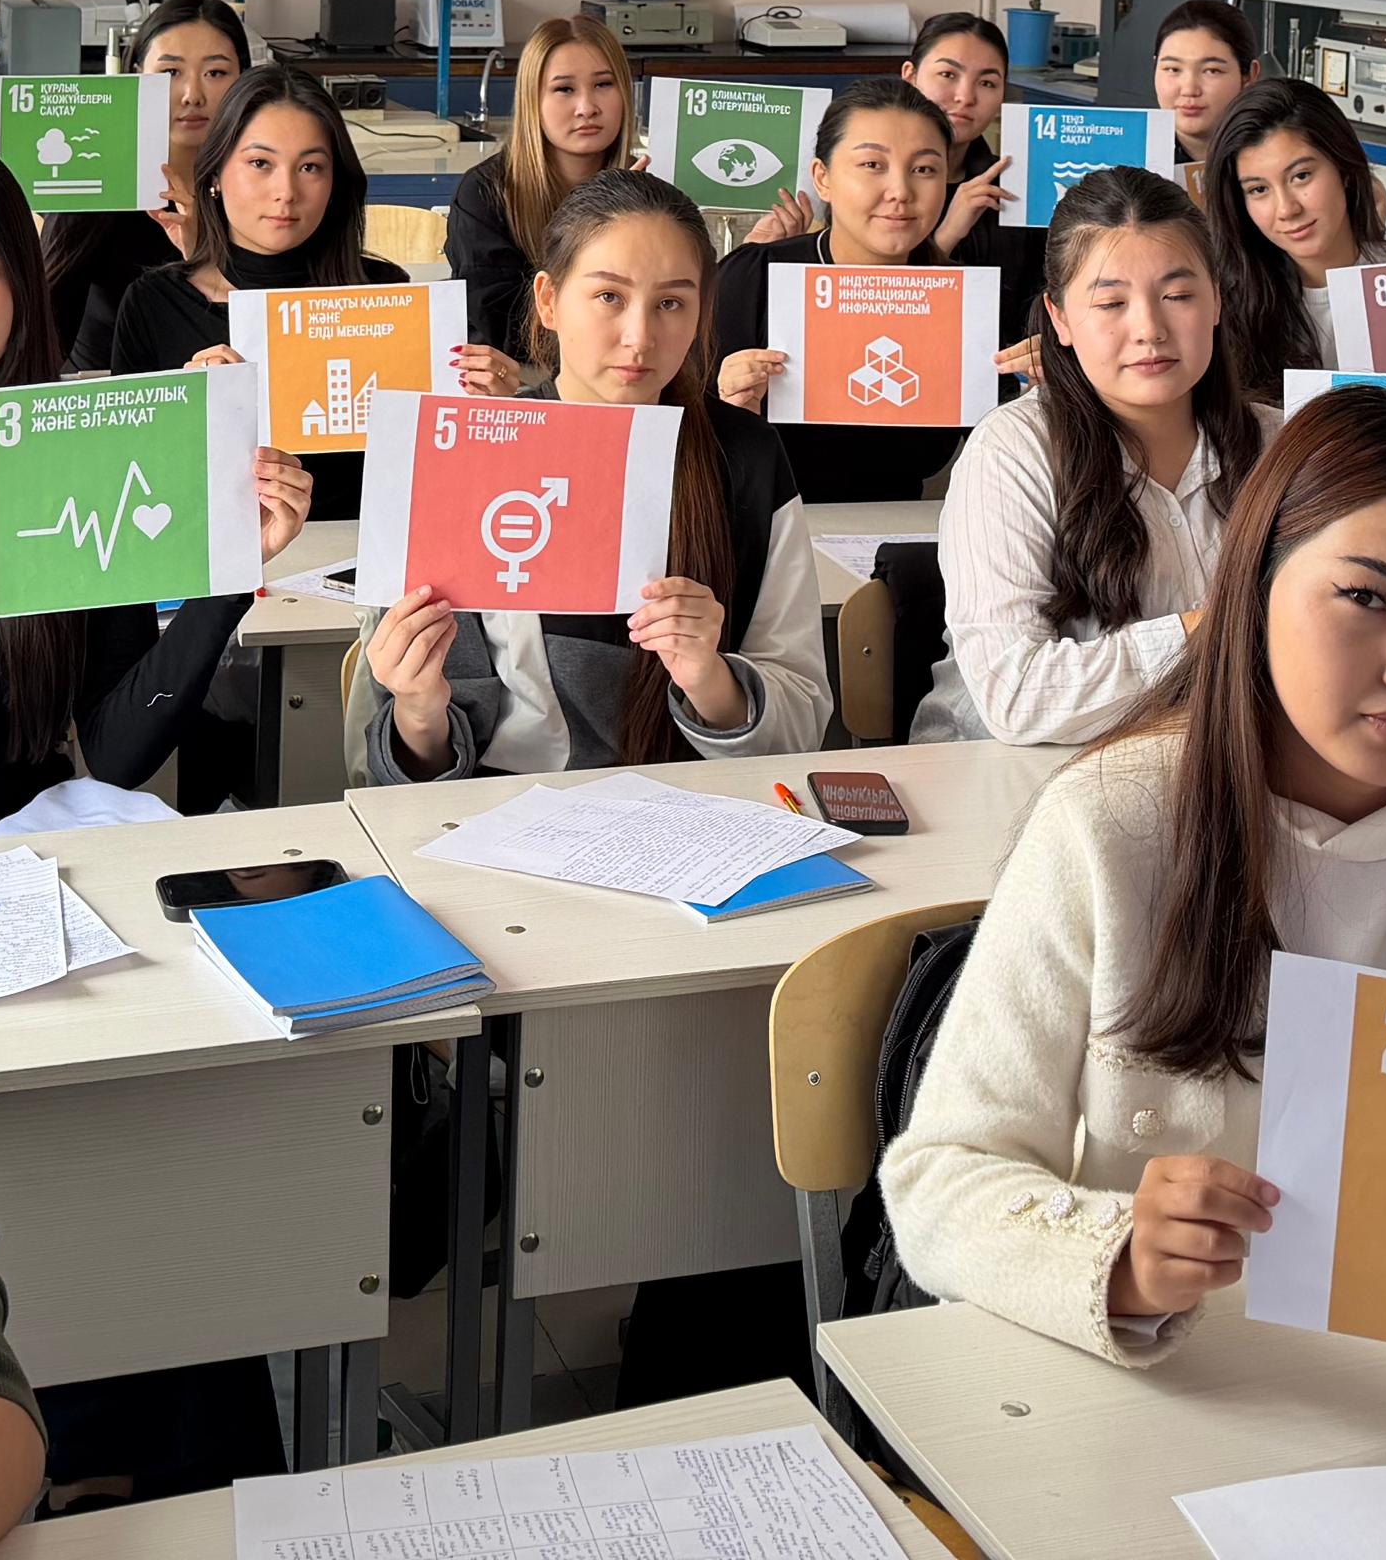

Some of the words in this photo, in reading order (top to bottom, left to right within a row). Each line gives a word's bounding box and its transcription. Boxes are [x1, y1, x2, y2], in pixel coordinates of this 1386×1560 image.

[40, 83, 80, 95] ҚҰРЛЫҚ
[712, 90, 765, 103] КЛИМАТТЫҢ
[9, 84, 34, 112] 15
[40, 93, 112, 104] ЭКОЖҮЙЕЛЕРІН
[685, 88, 708, 116] 13
[40, 106, 76, 117] САҚТАУ
[712, 100, 763, 113] ӨЗГЕРУІМЕН
[764, 104, 791, 115] КҮРЕС
[1034, 114, 1056, 140] 14
[1062, 115, 1084, 125] ТЕҢІЗ
[1061, 124, 1123, 136] ЭКОЖҮЙЕЛЕРІН
[1061, 135, 1092, 145] САҚТАУ
[838, 275, 958, 290] ИНДУСТРИЯЛАНДЫРУ,
[815, 275, 833, 309] 9
[838, 289, 929, 303] ИННОВАЦИЯЛАР,
[308, 297, 358, 312] ТҰРАҚТЫ
[360, 295, 413, 311] ҚАЛАЛАР
[838, 302, 931, 316] ИНФРАҚҰРЫЛЫМ
[278, 300, 303, 335] 11
[308, 312, 341, 324] ЖӘНЕ
[308, 327, 334, 340] ЕЛДІ
[337, 323, 395, 338] МЕКЕНДЕР
[31, 393, 90, 414] ЖАҚСЫ
[94, 385, 188, 411] ДЕНСАУЛЫҚ
[31, 413, 76, 433] ЖӘНЕ
[80, 407, 156, 428] ӘЛ-АУҚАТ
[468, 408, 548, 426] ГЕНДЕРЛІК
[434, 406, 458, 450] 5
